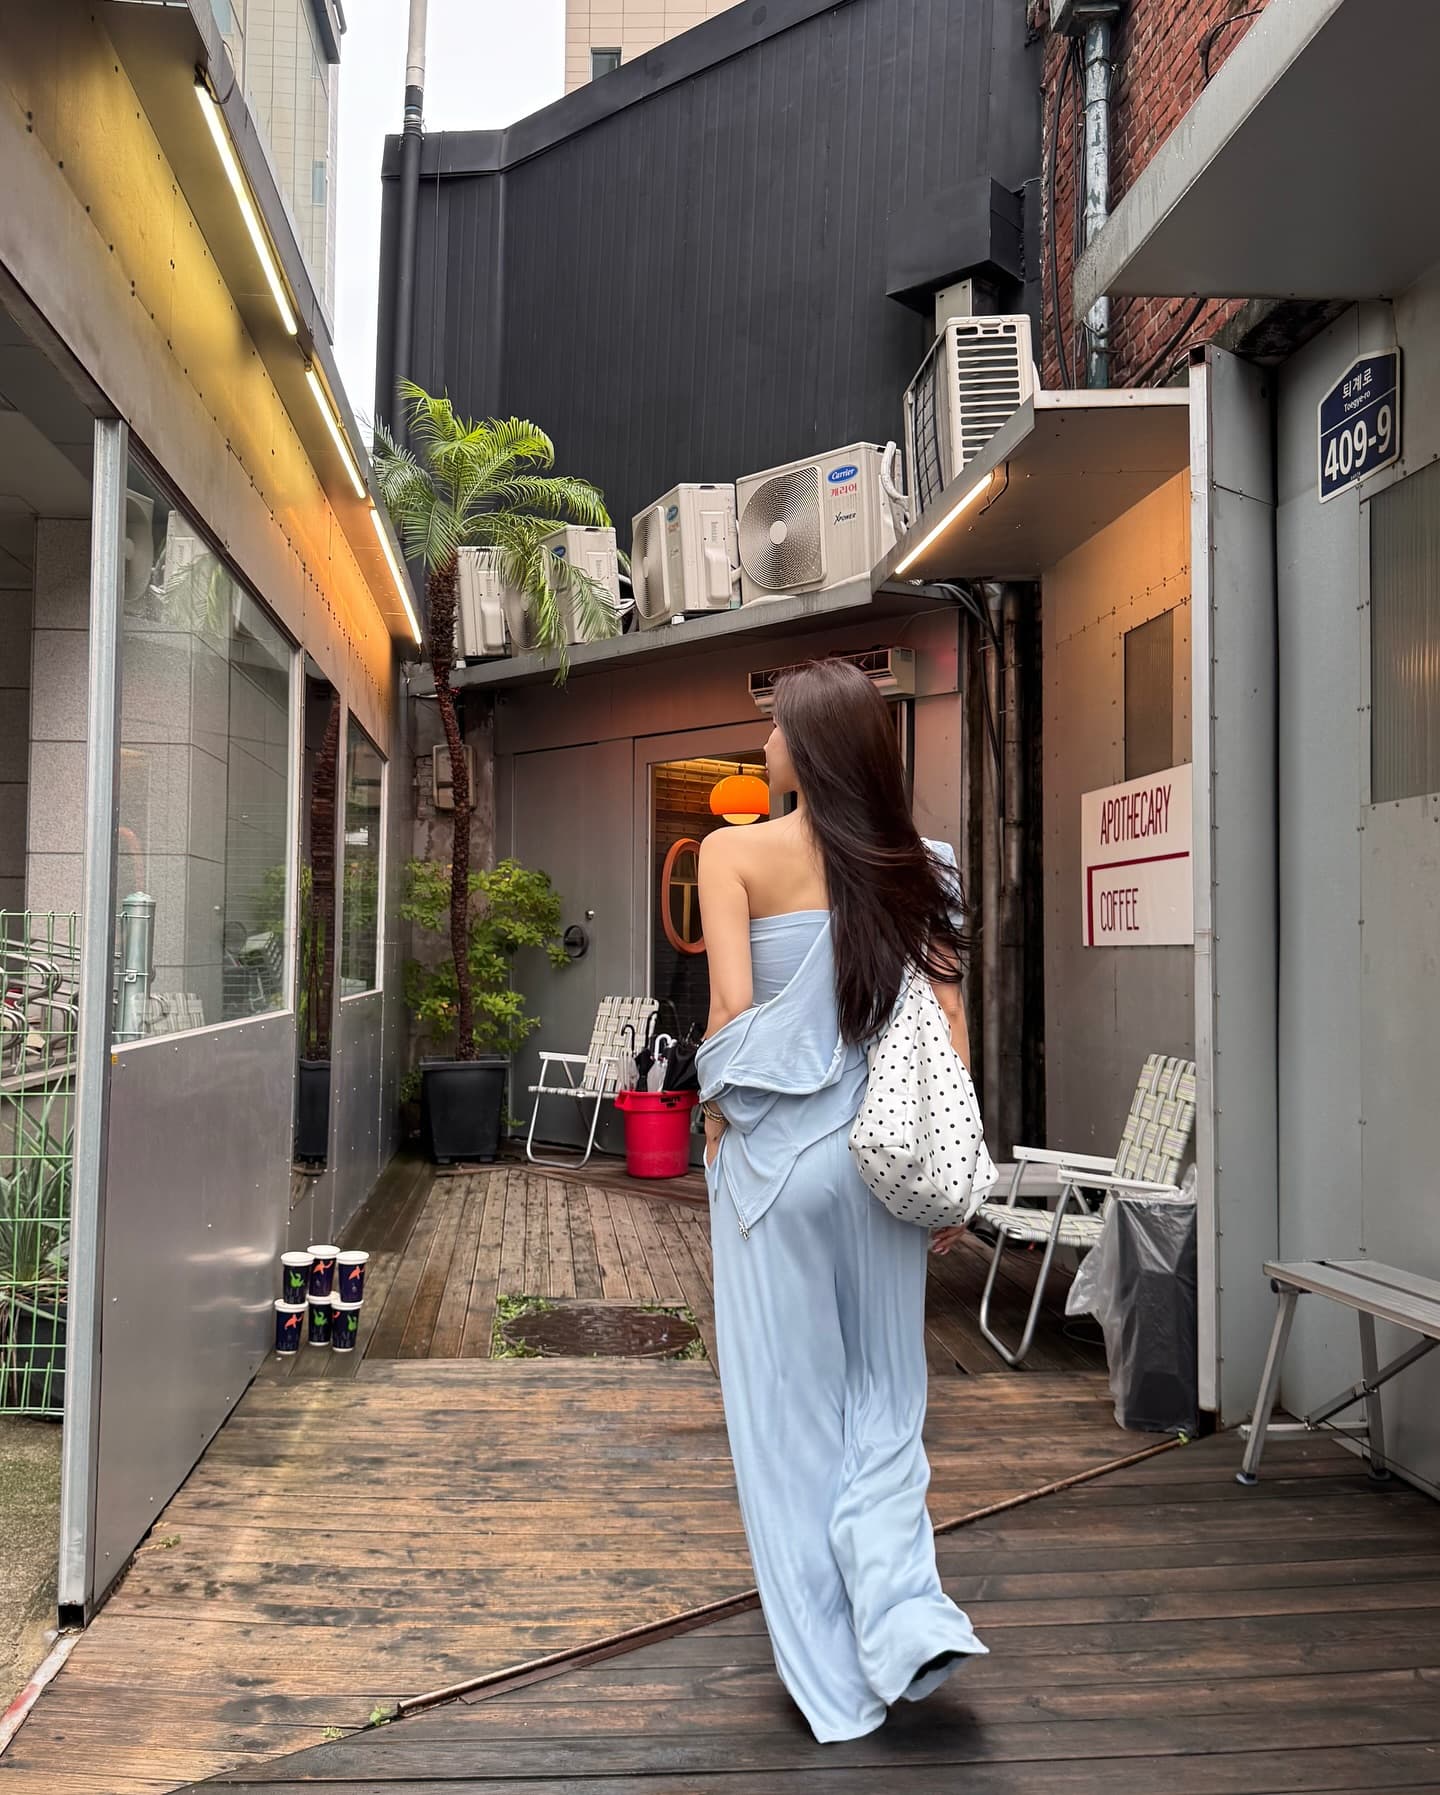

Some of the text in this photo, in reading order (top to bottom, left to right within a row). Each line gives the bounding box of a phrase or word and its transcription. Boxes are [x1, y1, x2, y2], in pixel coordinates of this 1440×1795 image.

[1342, 367, 1373, 399] 퇴계로
[1324, 404, 1392, 481] 409-9
[831, 468, 855, 480] Carrier
[831, 482, 857, 497] 캐리어
[1100, 784, 1172, 845] APOTHECARY
[1100, 888, 1140, 932] COFFEE
